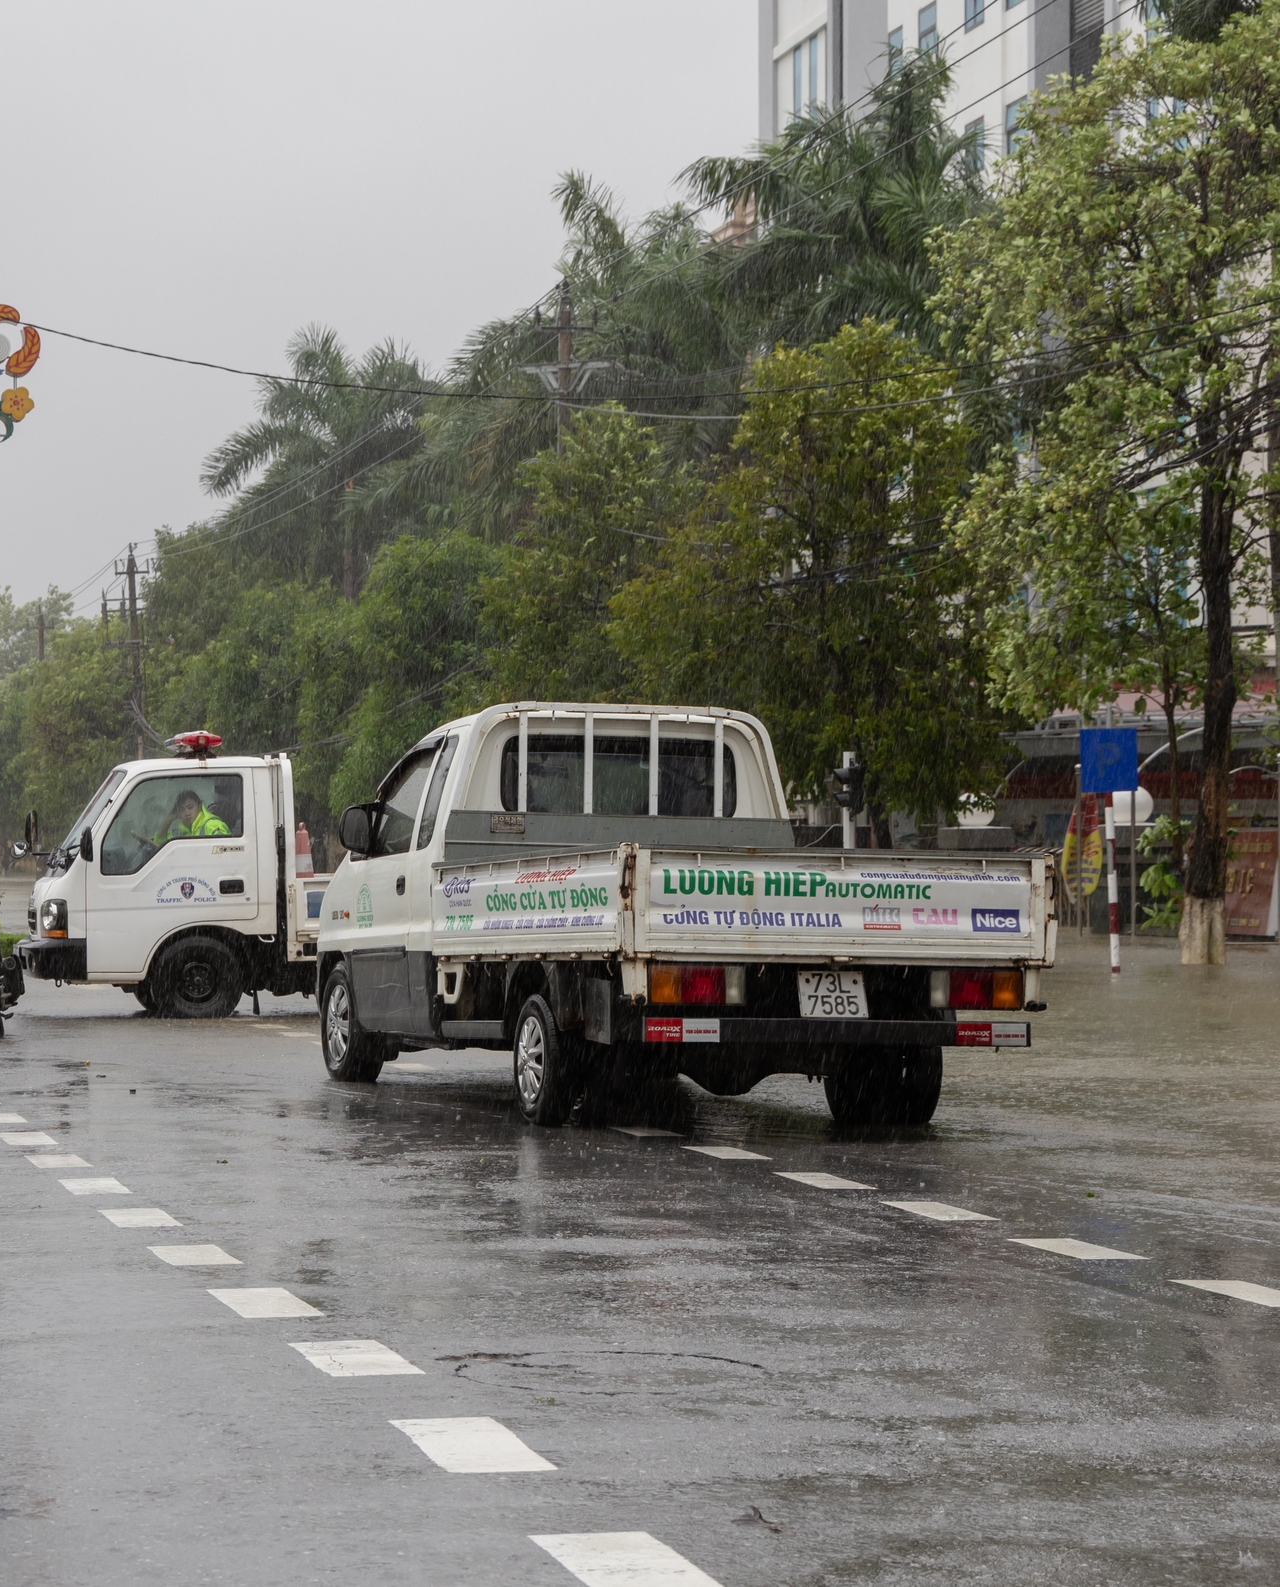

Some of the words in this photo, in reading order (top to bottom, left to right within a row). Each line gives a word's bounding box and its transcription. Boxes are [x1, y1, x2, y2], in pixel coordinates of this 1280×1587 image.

[1098, 742, 1120, 778] P
[548, 866, 577, 884] HIỆP
[662, 869, 755, 896] LUONG
[486, 884, 517, 912] CỔNG
[520, 884, 547, 911] CỬA
[549, 888, 567, 913] TỰ
[570, 883, 608, 912] ĐỘNG
[456, 914, 474, 930] 7585
[714, 910, 736, 929] TỰ
[740, 909, 786, 929] ĐỘNG
[790, 912, 842, 927] ITALIA
[975, 914, 1017, 928] Nice
[810, 974, 851, 994] 73L
[809, 995, 860, 1016] 7585
